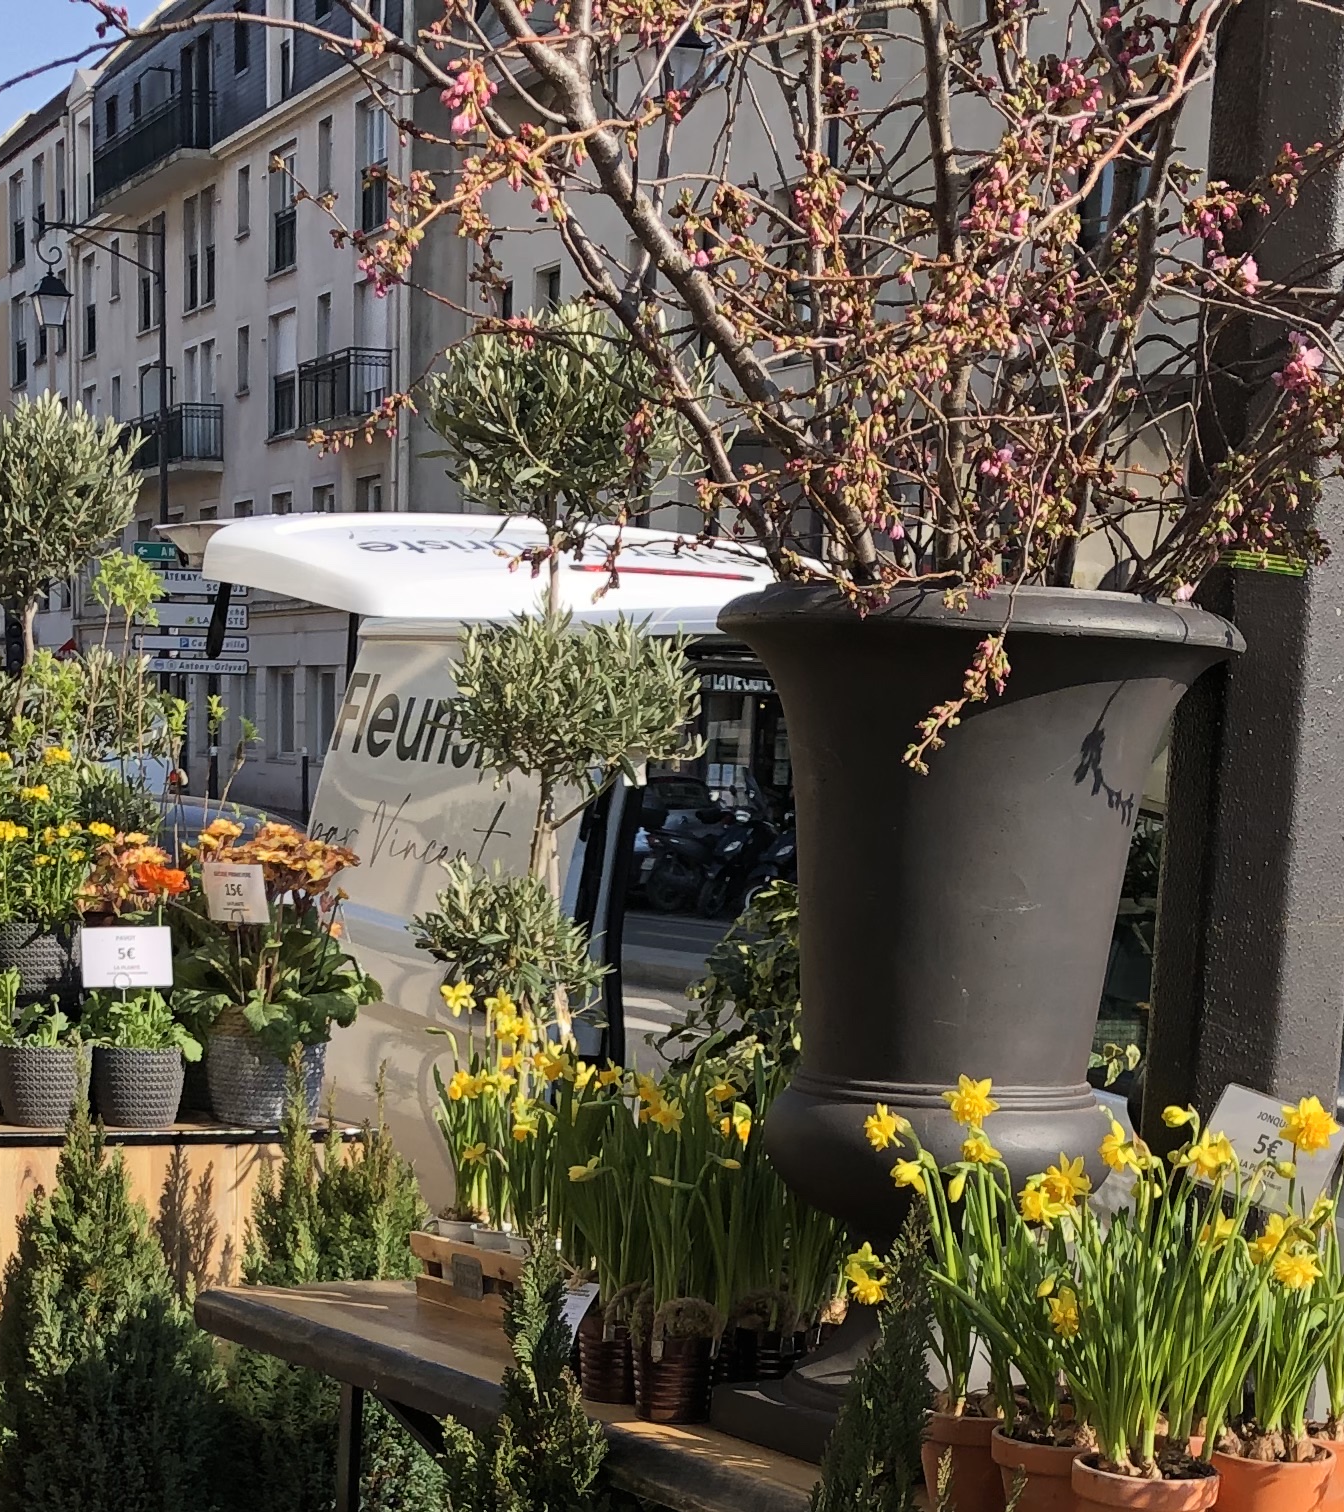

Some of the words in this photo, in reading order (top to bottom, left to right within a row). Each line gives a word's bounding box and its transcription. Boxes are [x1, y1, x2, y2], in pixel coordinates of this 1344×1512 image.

[225, 883, 244, 897] 15€
[118, 947, 136, 960] 5€
[1253, 1133, 1283, 1160] 5€
[1239, 1159, 1248, 1168] LA
